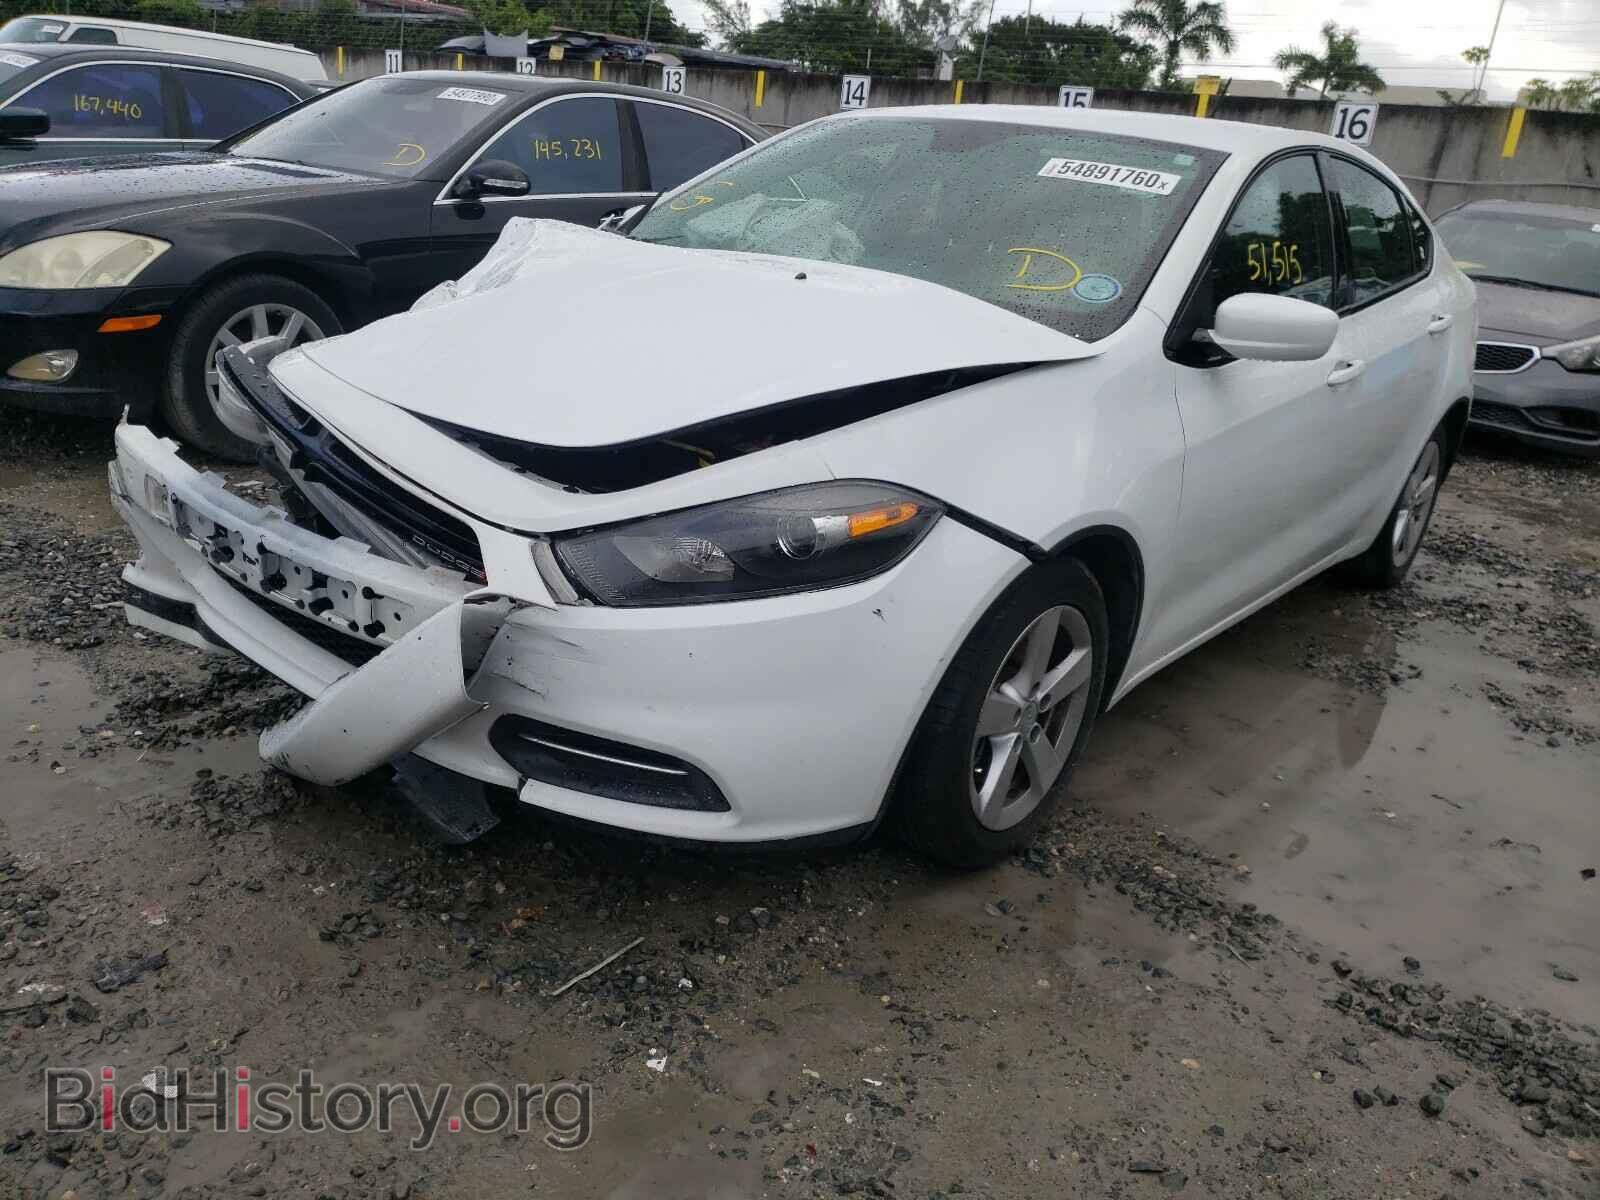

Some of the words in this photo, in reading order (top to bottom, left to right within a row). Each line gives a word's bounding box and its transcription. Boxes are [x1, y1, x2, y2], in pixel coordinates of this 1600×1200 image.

[388, 53, 399, 73] 11
[665, 70, 682, 94] 13
[844, 79, 865, 106] 14
[74, 93, 142, 119] 167,440
[1063, 91, 1087, 108] 15
[1335, 107, 1370, 140] 16
[535, 138, 602, 160] 145,231
[1247, 240, 1303, 287] 51,515
